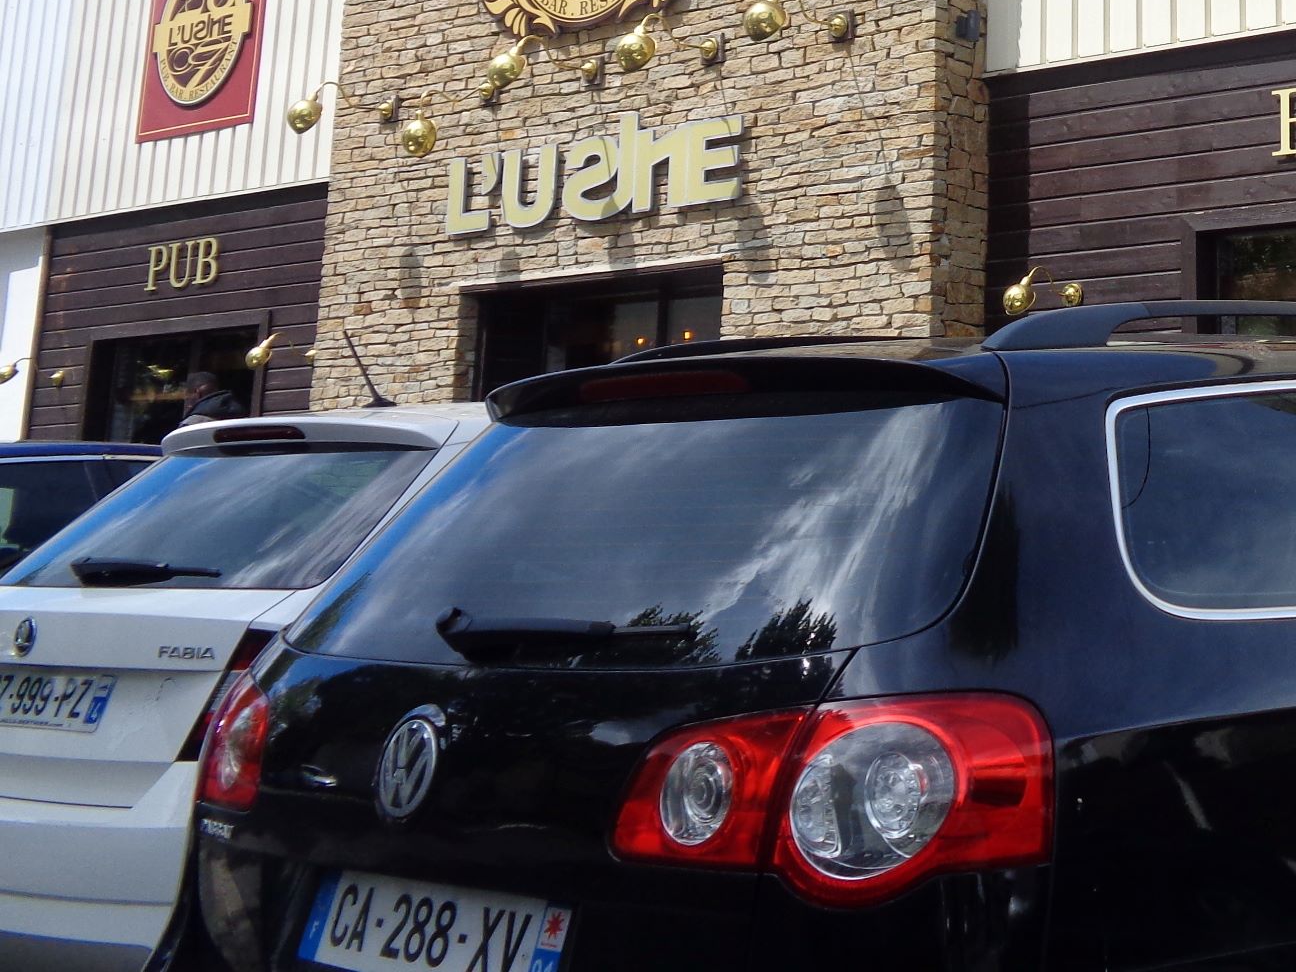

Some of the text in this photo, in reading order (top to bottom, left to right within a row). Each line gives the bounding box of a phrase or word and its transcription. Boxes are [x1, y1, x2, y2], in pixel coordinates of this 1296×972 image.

[169, 83, 184, 101] BAR
[143, 236, 220, 293] PUB
[157, 645, 216, 661] FABIA
[329, 883, 534, 972] CA-288-XV
